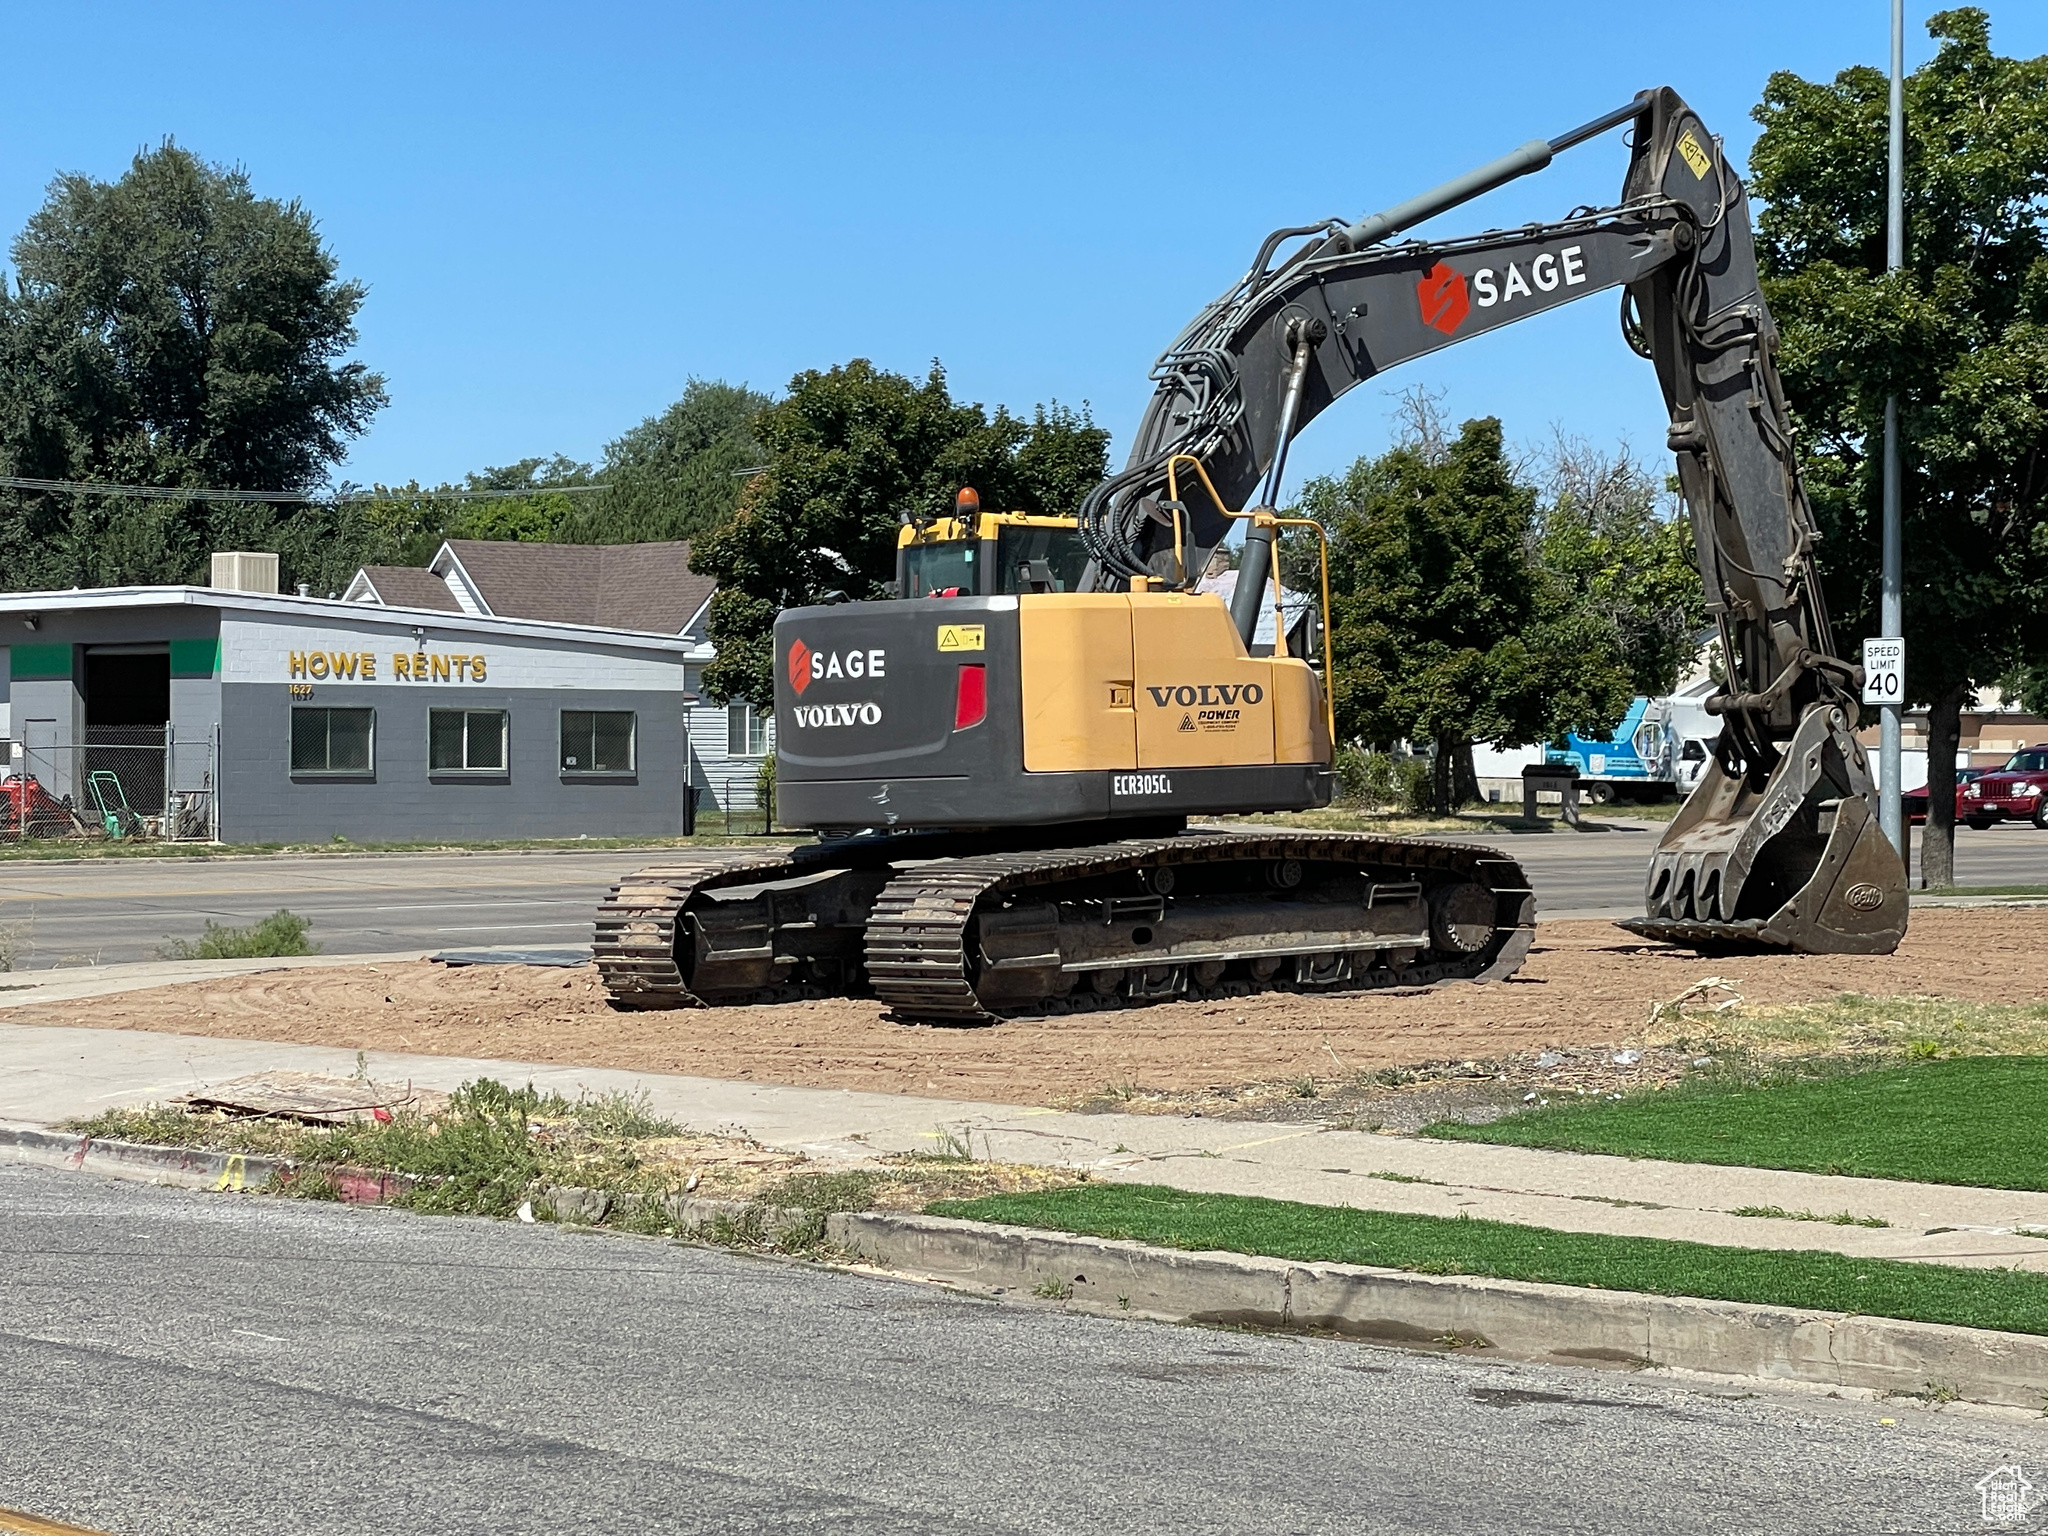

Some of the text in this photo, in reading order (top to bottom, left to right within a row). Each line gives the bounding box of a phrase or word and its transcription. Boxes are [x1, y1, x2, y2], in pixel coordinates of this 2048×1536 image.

[1474, 245, 1586, 307] SAGE
[1867, 646, 1900, 657] SPEED
[289, 651, 486, 677] HOWE RENTS
[811, 649, 886, 680] SAGE
[1870, 659, 1896, 670] LIMIT
[289, 684, 312, 694] 1627
[1146, 683, 1263, 707] VOLVO
[1868, 672, 1899, 696] 40
[793, 702, 882, 728] VOLVO
[1197, 709, 1240, 720] POWER
